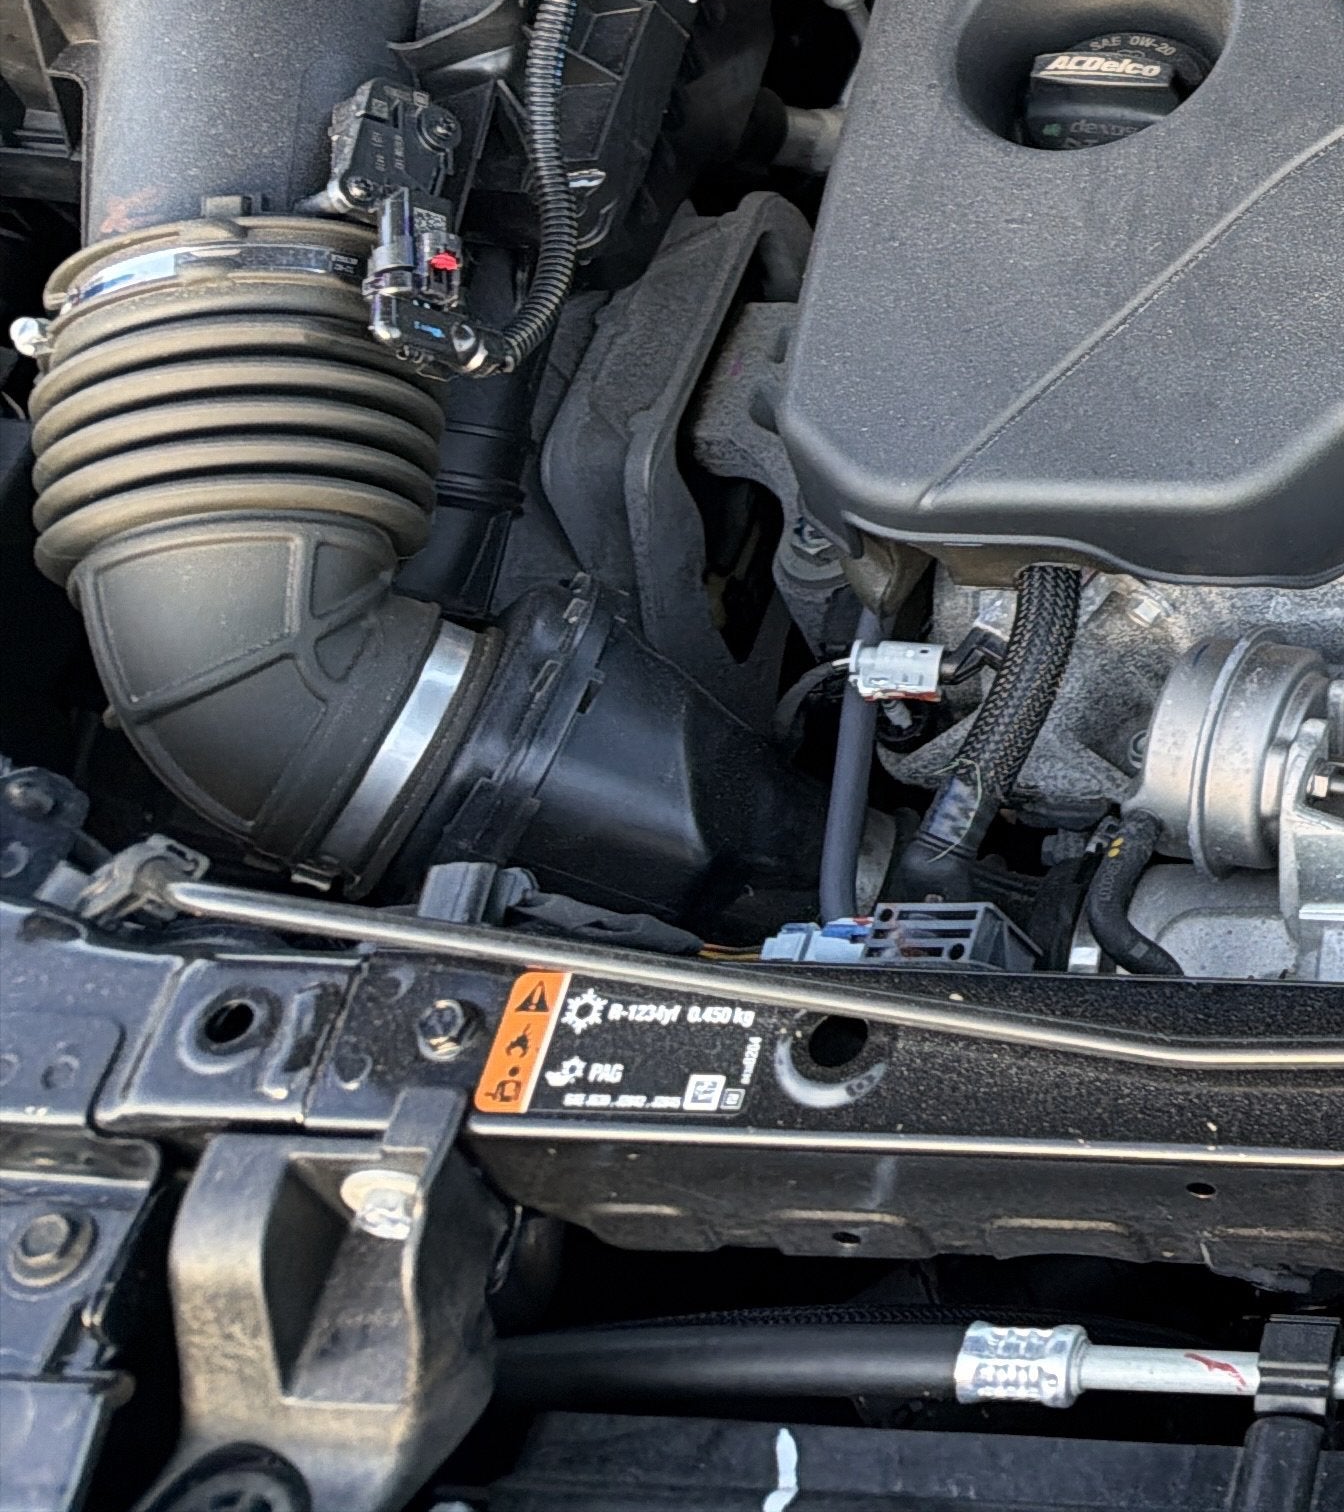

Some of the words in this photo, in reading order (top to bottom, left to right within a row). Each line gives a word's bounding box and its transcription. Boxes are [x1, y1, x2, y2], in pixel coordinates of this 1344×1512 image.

[1089, 37, 1121, 50] SAE
[1129, 35, 1177, 56] 0W-20
[1045, 55, 1161, 77] ACDelco
[686, 1005, 733, 1024] 0.450
[733, 1006, 756, 1029] kg
[587, 1062, 625, 1083] PAG
